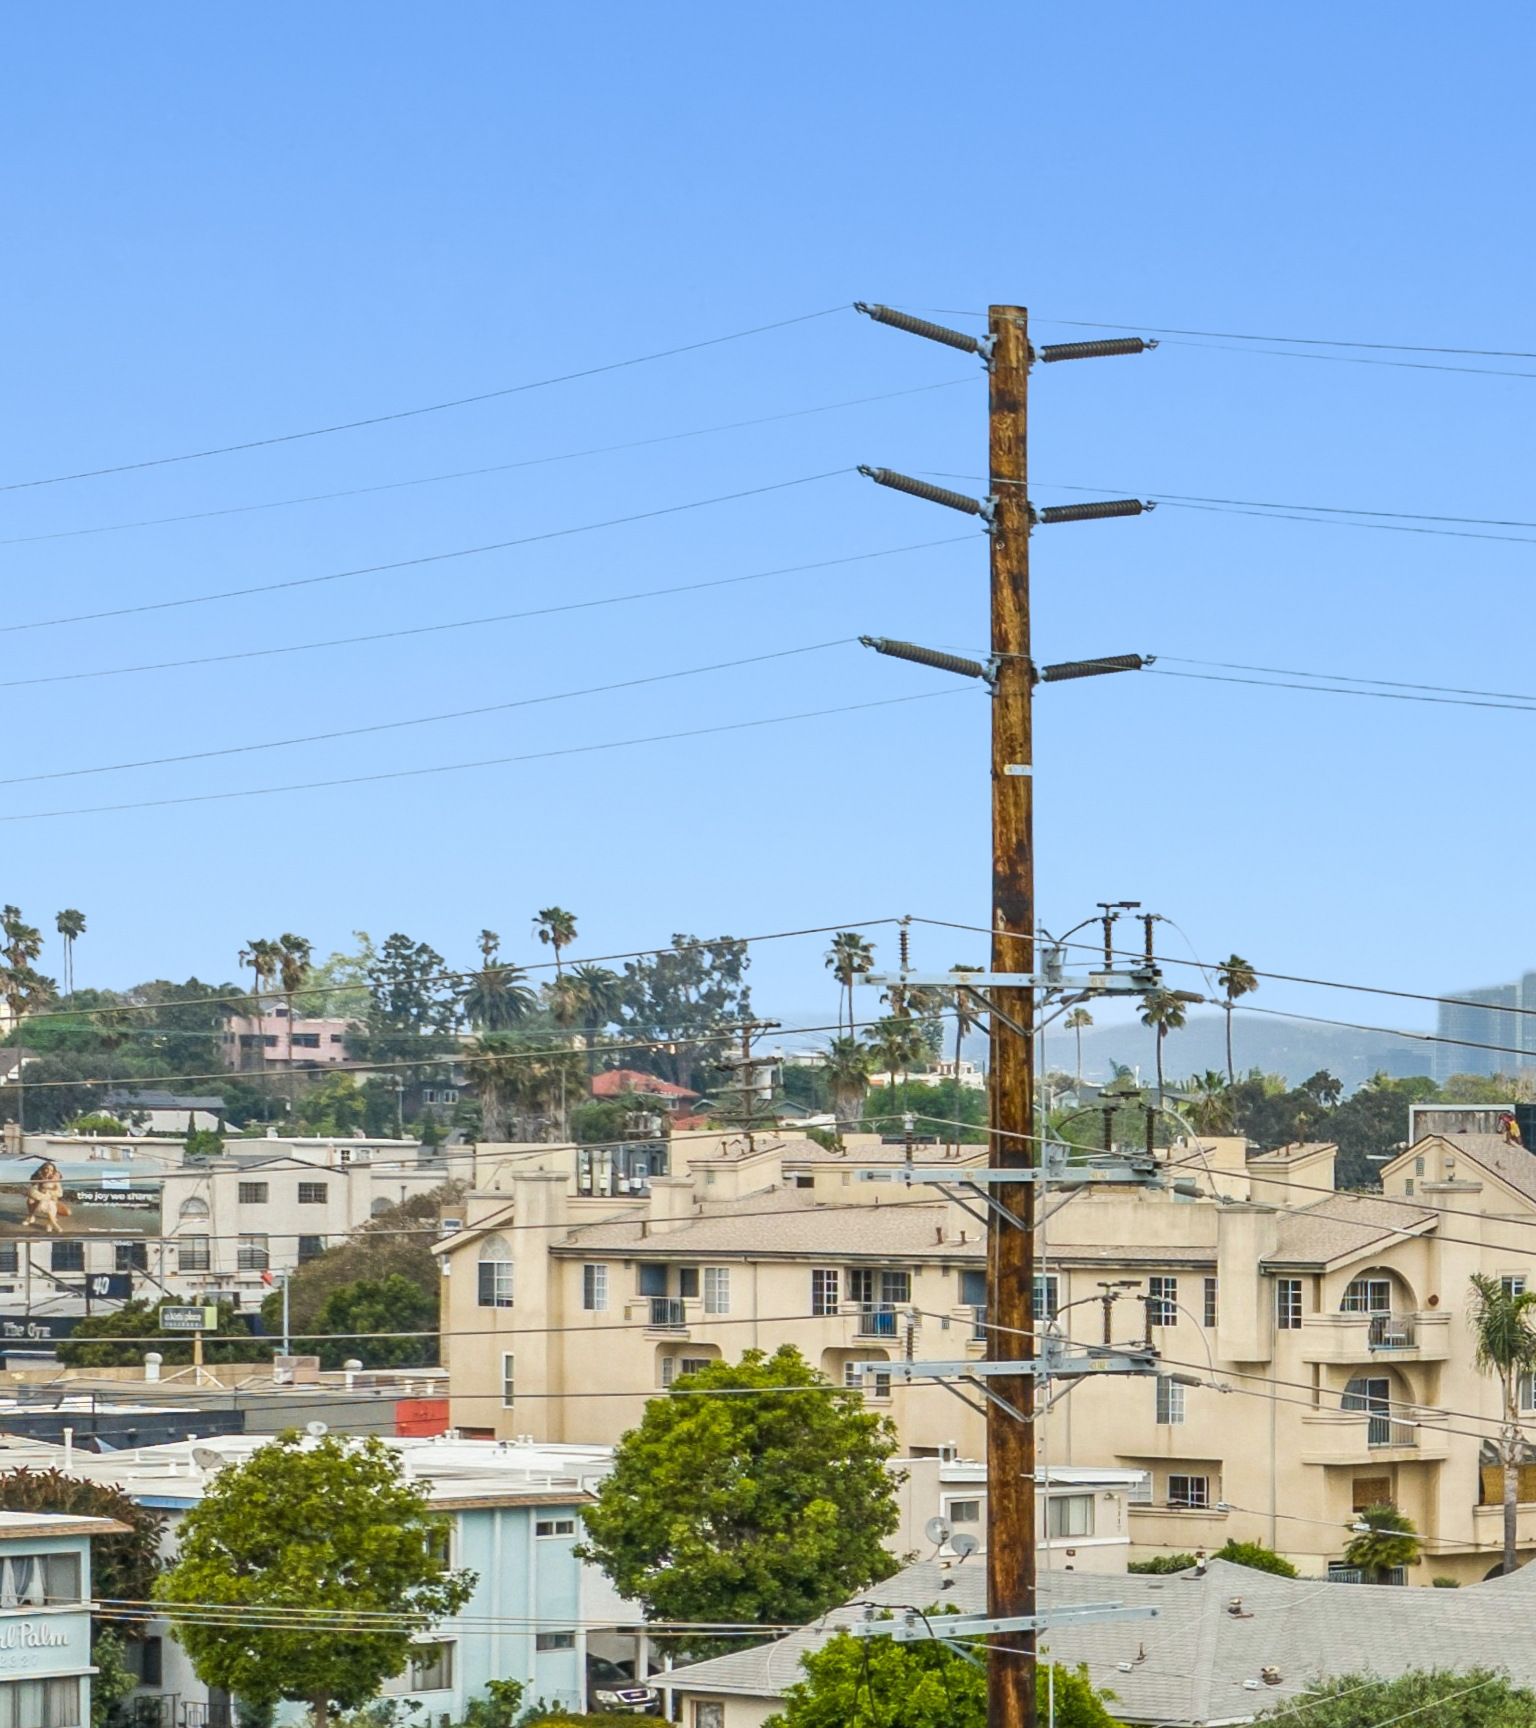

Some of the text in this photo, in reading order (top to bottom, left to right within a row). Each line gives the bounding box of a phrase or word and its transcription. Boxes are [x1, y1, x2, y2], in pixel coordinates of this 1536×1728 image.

[77, 1192, 93, 1200] the
[94, 1191, 110, 1201] joy
[20, 1621, 69, 1649] Palm
